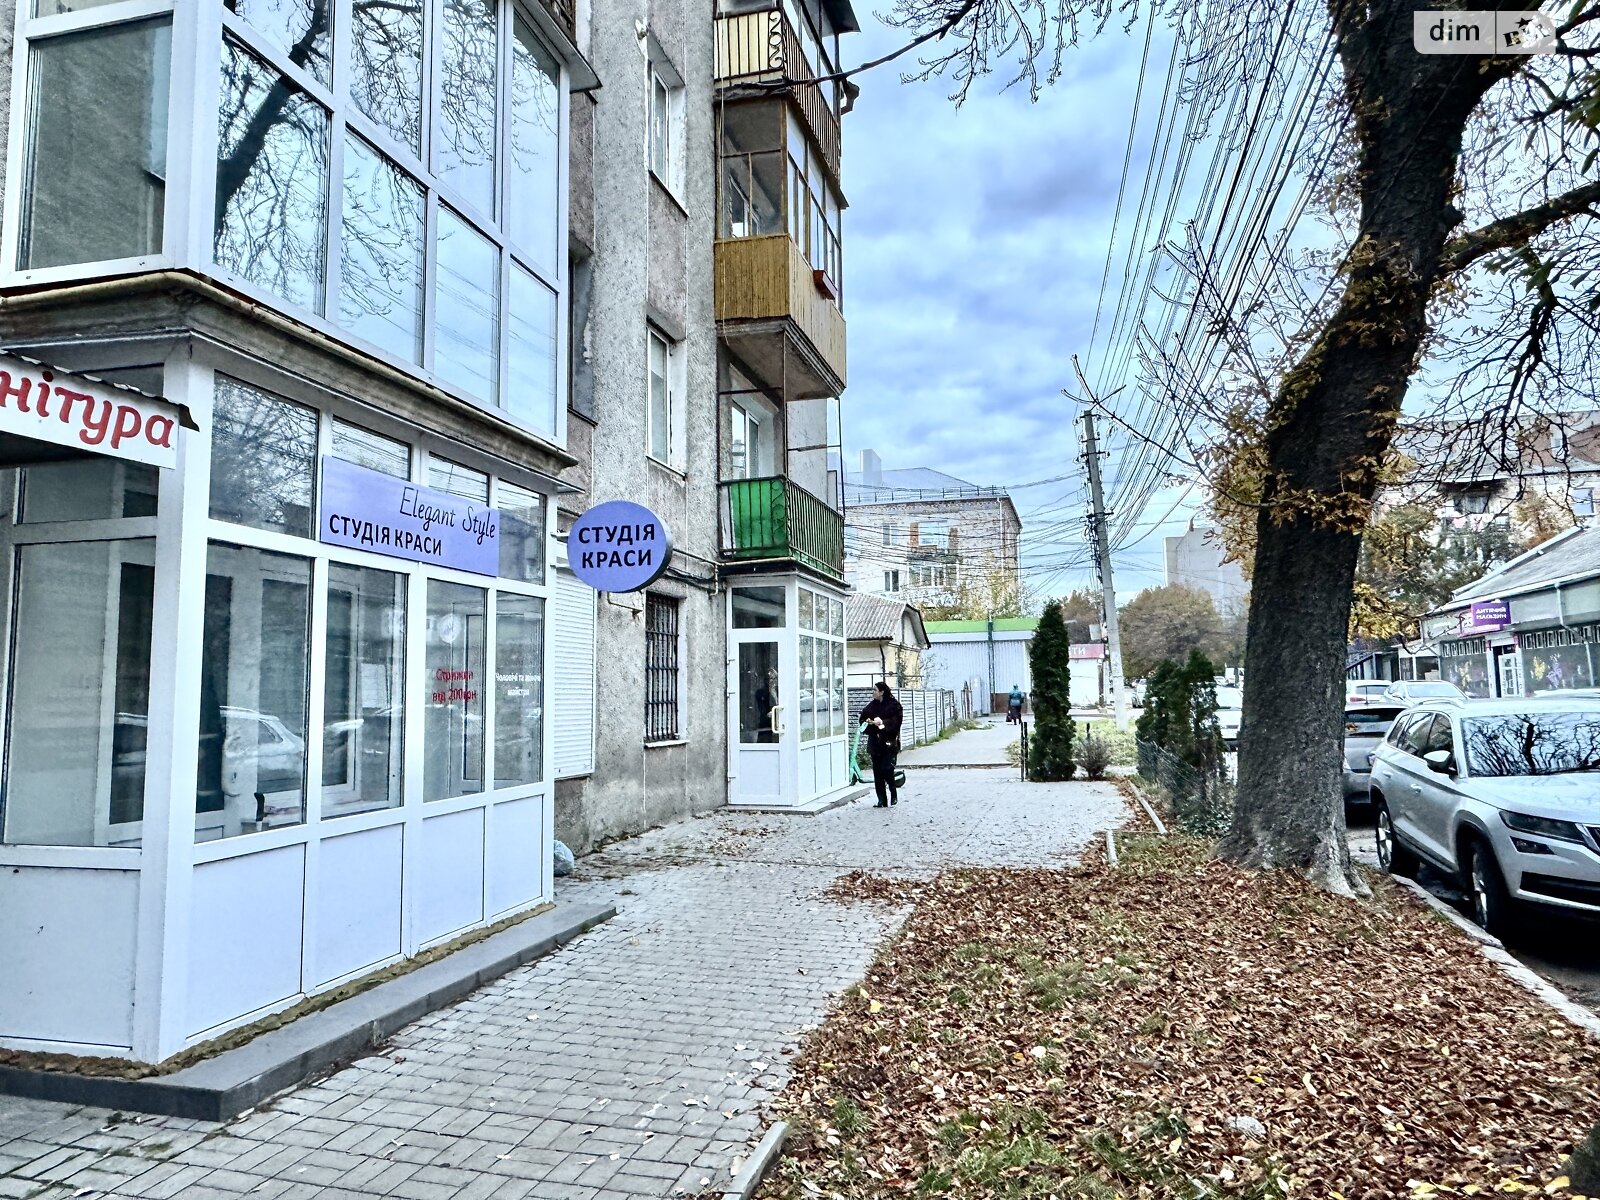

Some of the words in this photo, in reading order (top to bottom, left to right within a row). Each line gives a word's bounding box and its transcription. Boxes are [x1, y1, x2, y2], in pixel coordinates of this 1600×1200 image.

[399, 486, 456, 532] Elegant
[462, 505, 496, 545] Style
[329, 513, 390, 546] СТУДІЯ
[394, 529, 442, 557] КРАСИ
[578, 523, 655, 546] СТУДІЯ
[582, 549, 652, 569] КРАСИ
